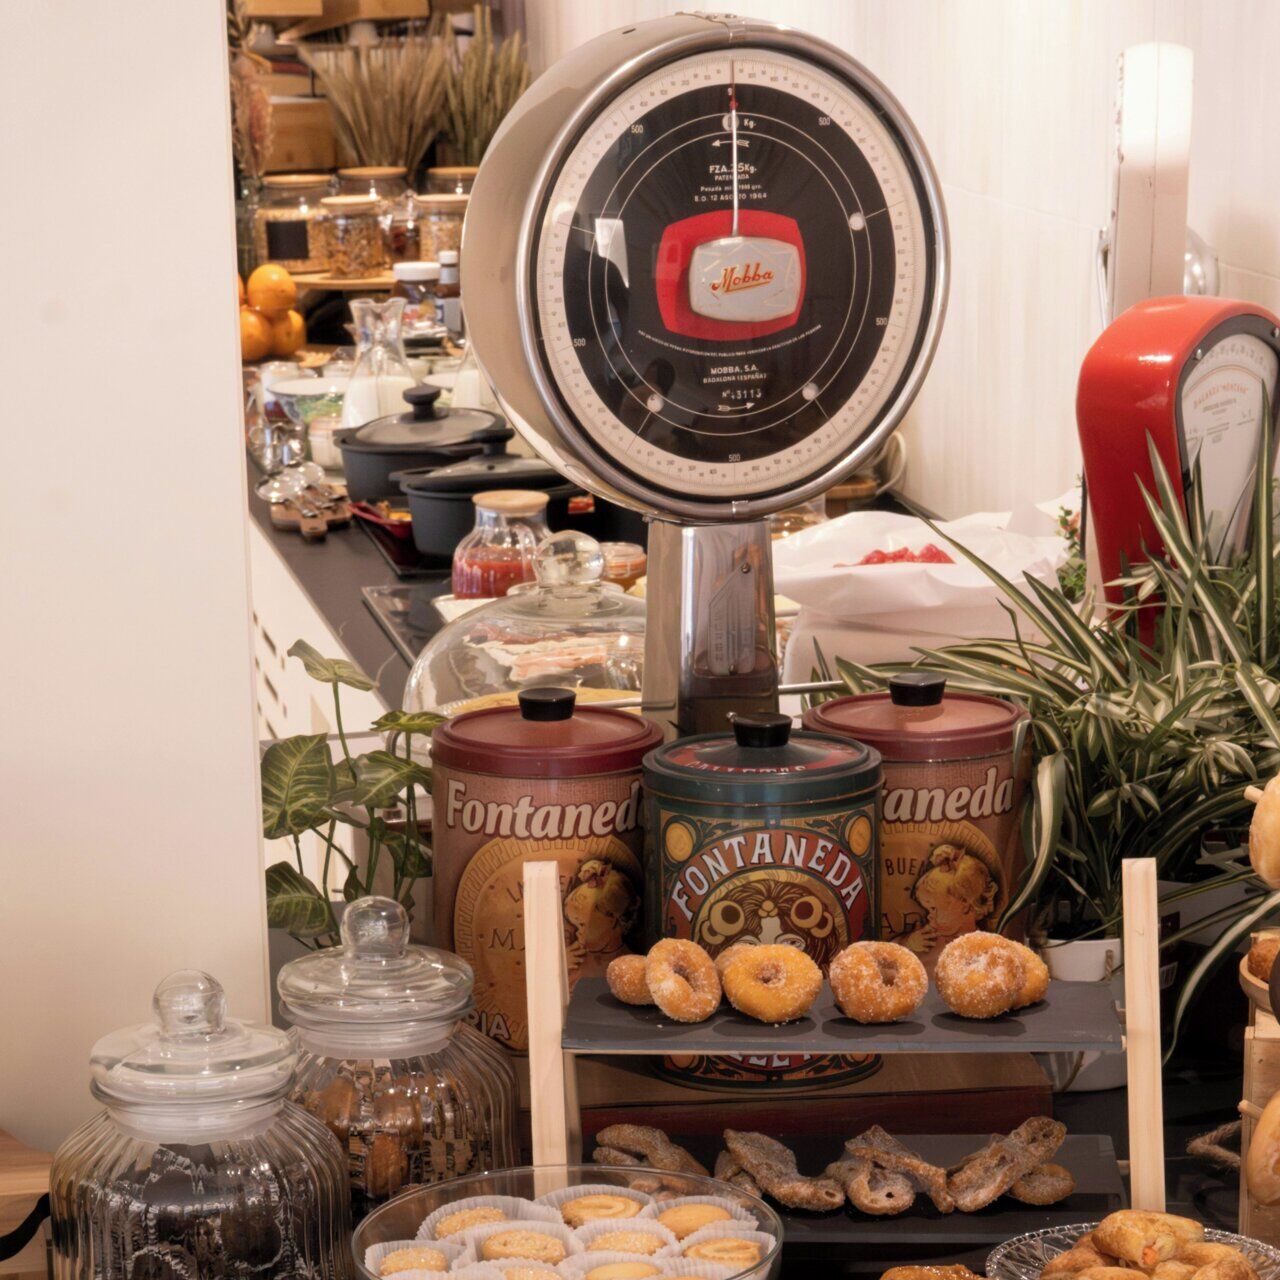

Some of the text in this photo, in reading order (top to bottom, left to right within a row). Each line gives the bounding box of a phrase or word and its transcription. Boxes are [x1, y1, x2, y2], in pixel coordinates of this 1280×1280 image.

[818, 117, 831, 126] 500
[631, 124, 644, 134] 500
[720, 193, 747, 201] AGOTO
[711, 263, 774, 293] Mobba
[875, 317, 888, 326] 500
[573, 338, 586, 347] 500
[728, 453, 741, 463] 500
[881, 765, 1015, 822] aneda
[446, 778, 642, 839] Fontaned
[885, 857, 927, 877] BUE
[671, 833, 864, 922] FONTANEDA
